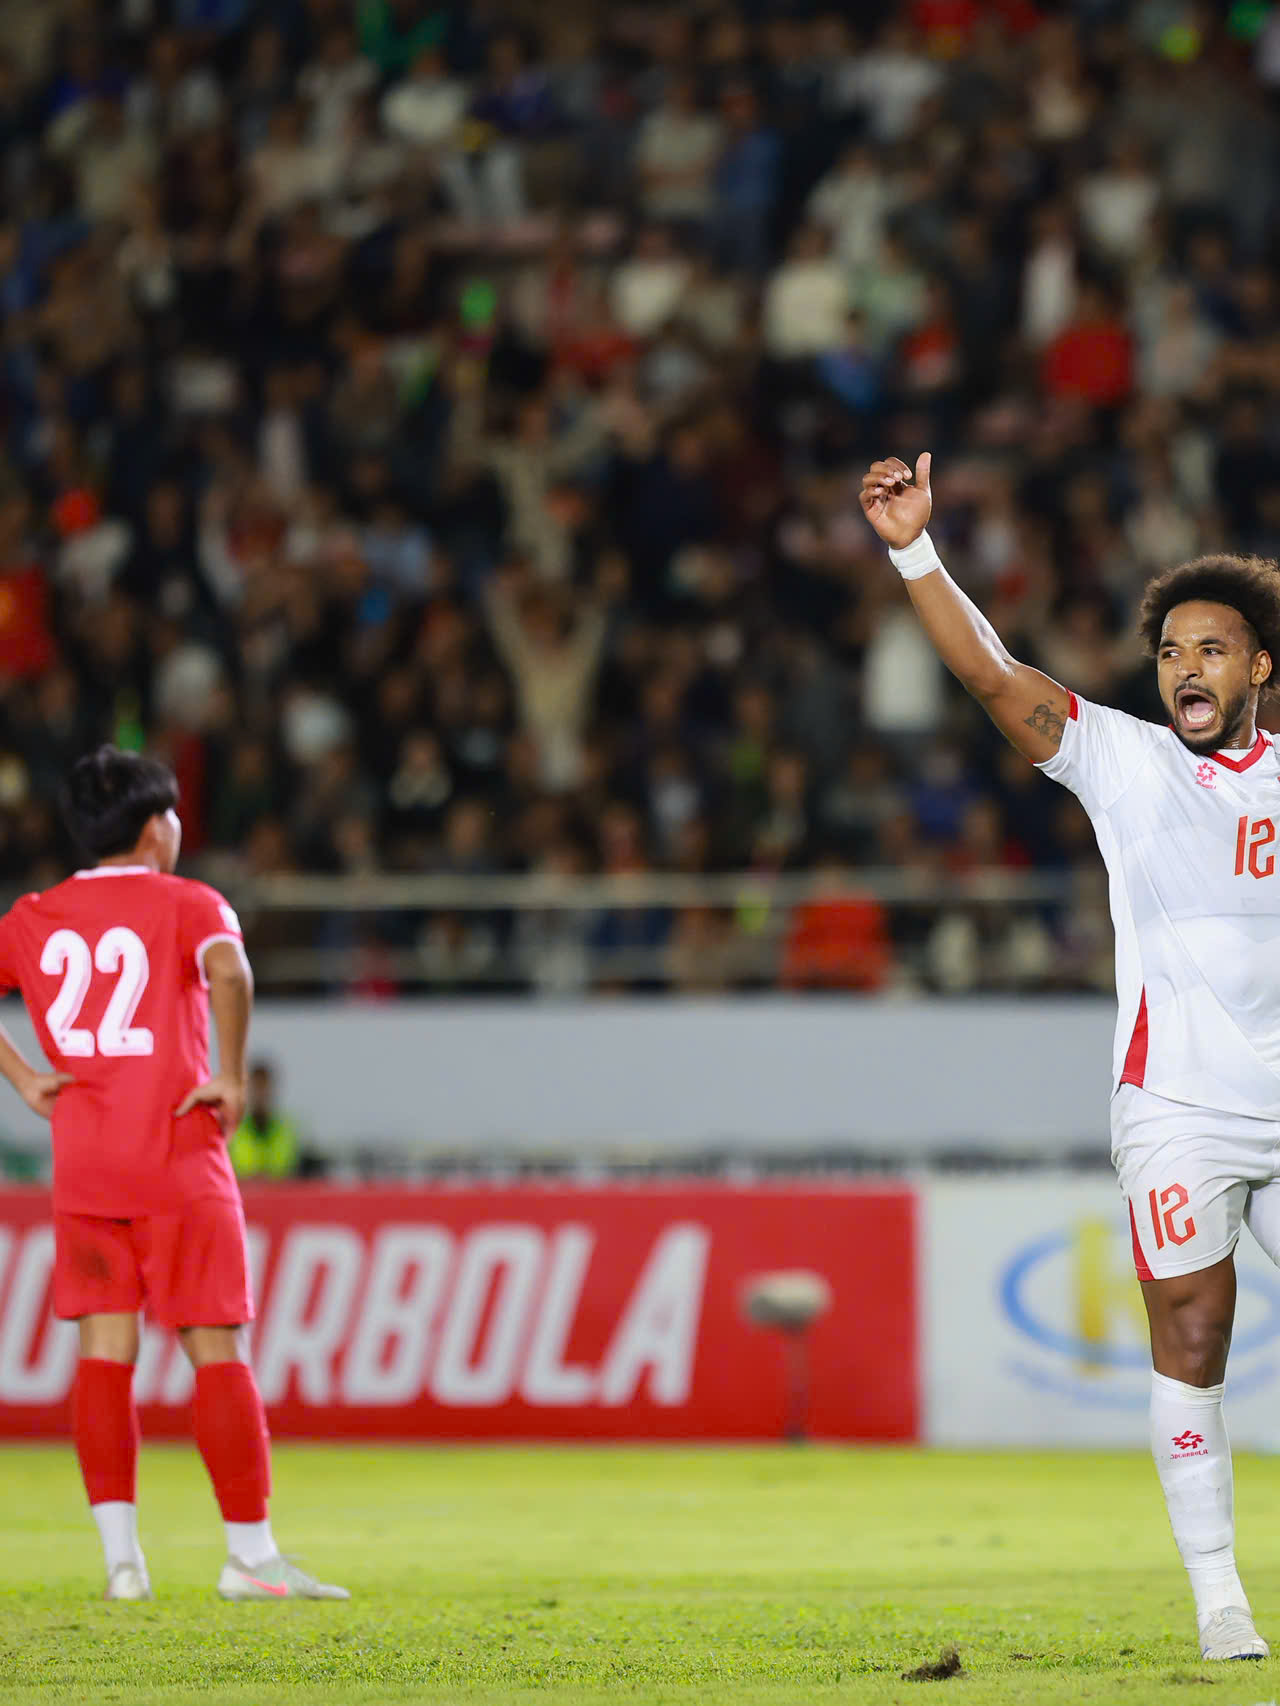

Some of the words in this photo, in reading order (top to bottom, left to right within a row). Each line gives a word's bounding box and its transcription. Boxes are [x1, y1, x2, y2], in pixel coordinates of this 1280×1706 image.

[1234, 815, 1276, 879] 12
[40, 926, 154, 1057] 22
[1148, 1182, 1197, 1251] 12
